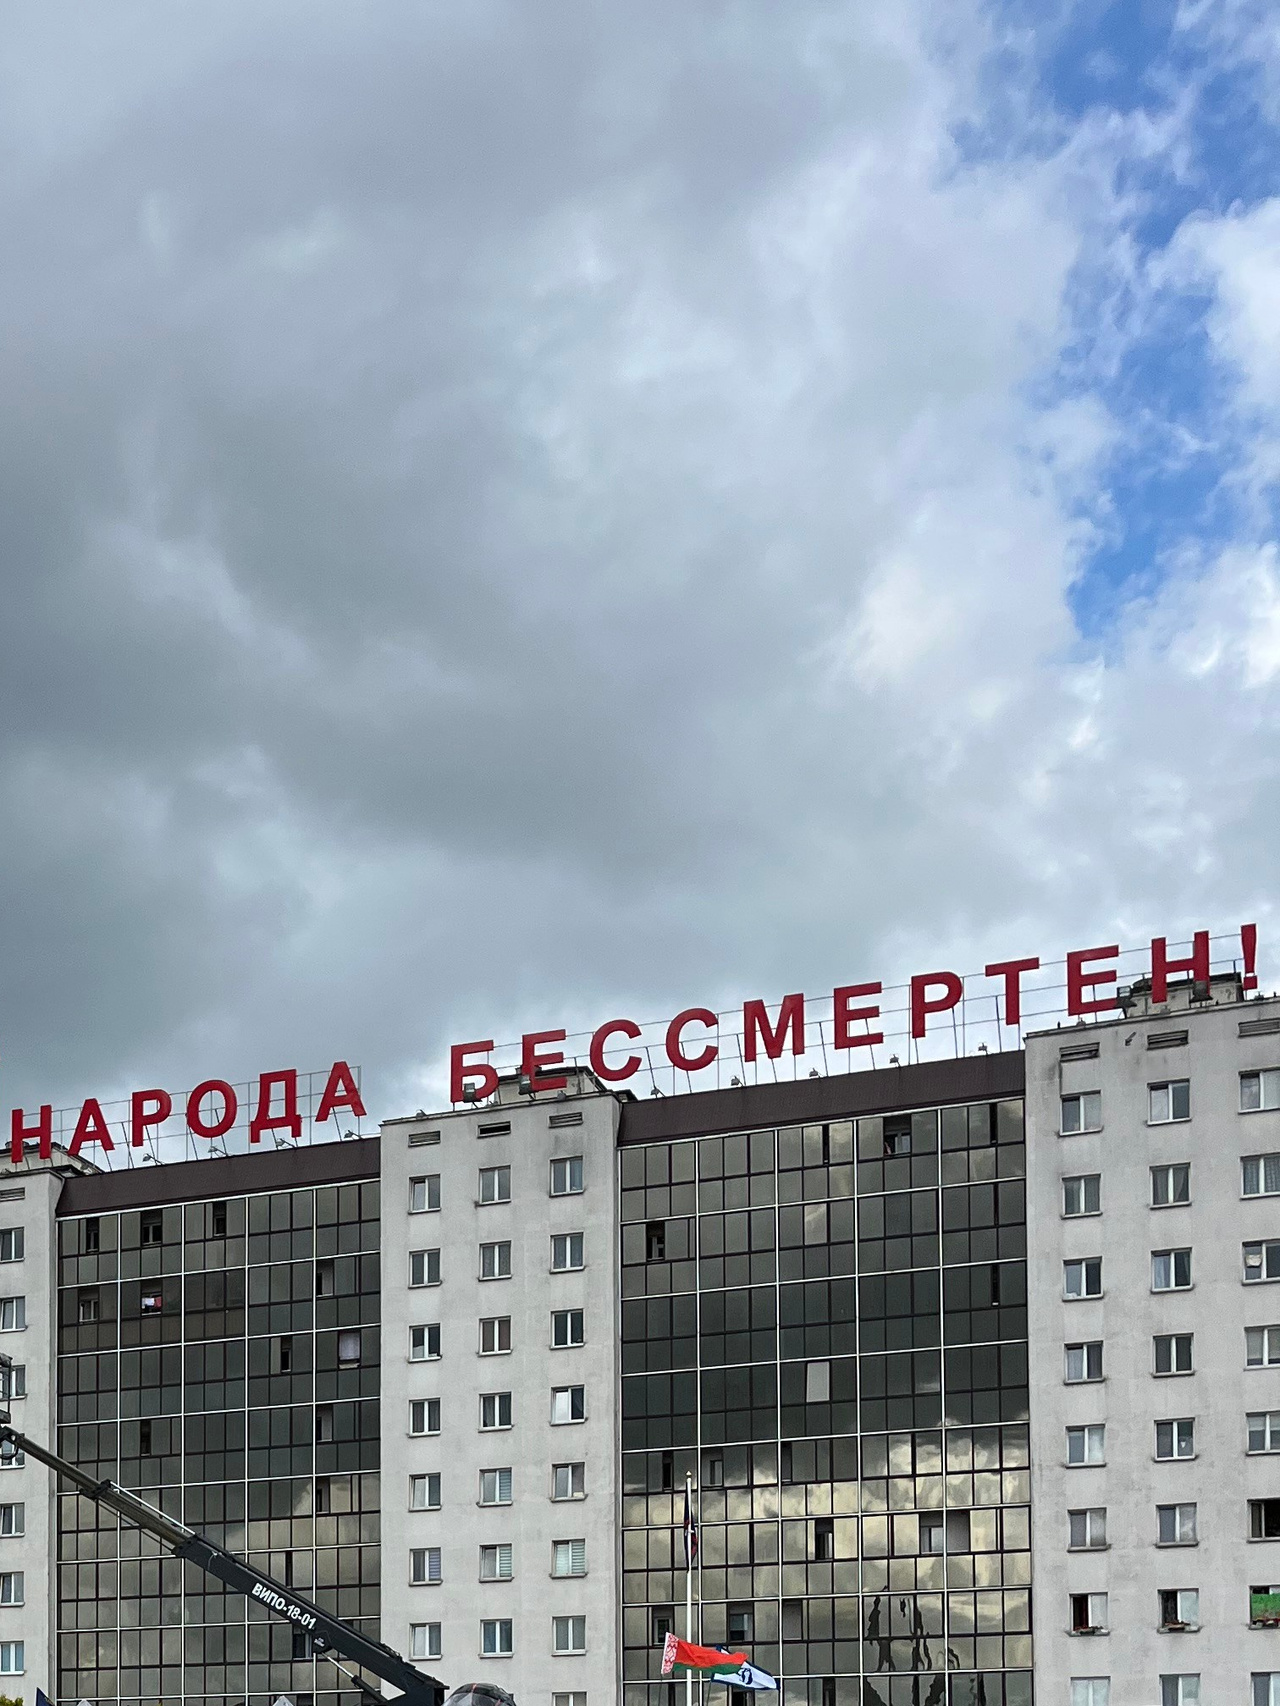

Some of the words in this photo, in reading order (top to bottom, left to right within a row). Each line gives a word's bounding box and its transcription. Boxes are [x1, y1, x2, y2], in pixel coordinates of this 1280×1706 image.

[9, 1061, 367, 1165] НАРОДА
[449, 923, 1258, 1104] БЕССМЕРТЕН!
[251, 1582, 317, 1629] ВИПО-18-01
